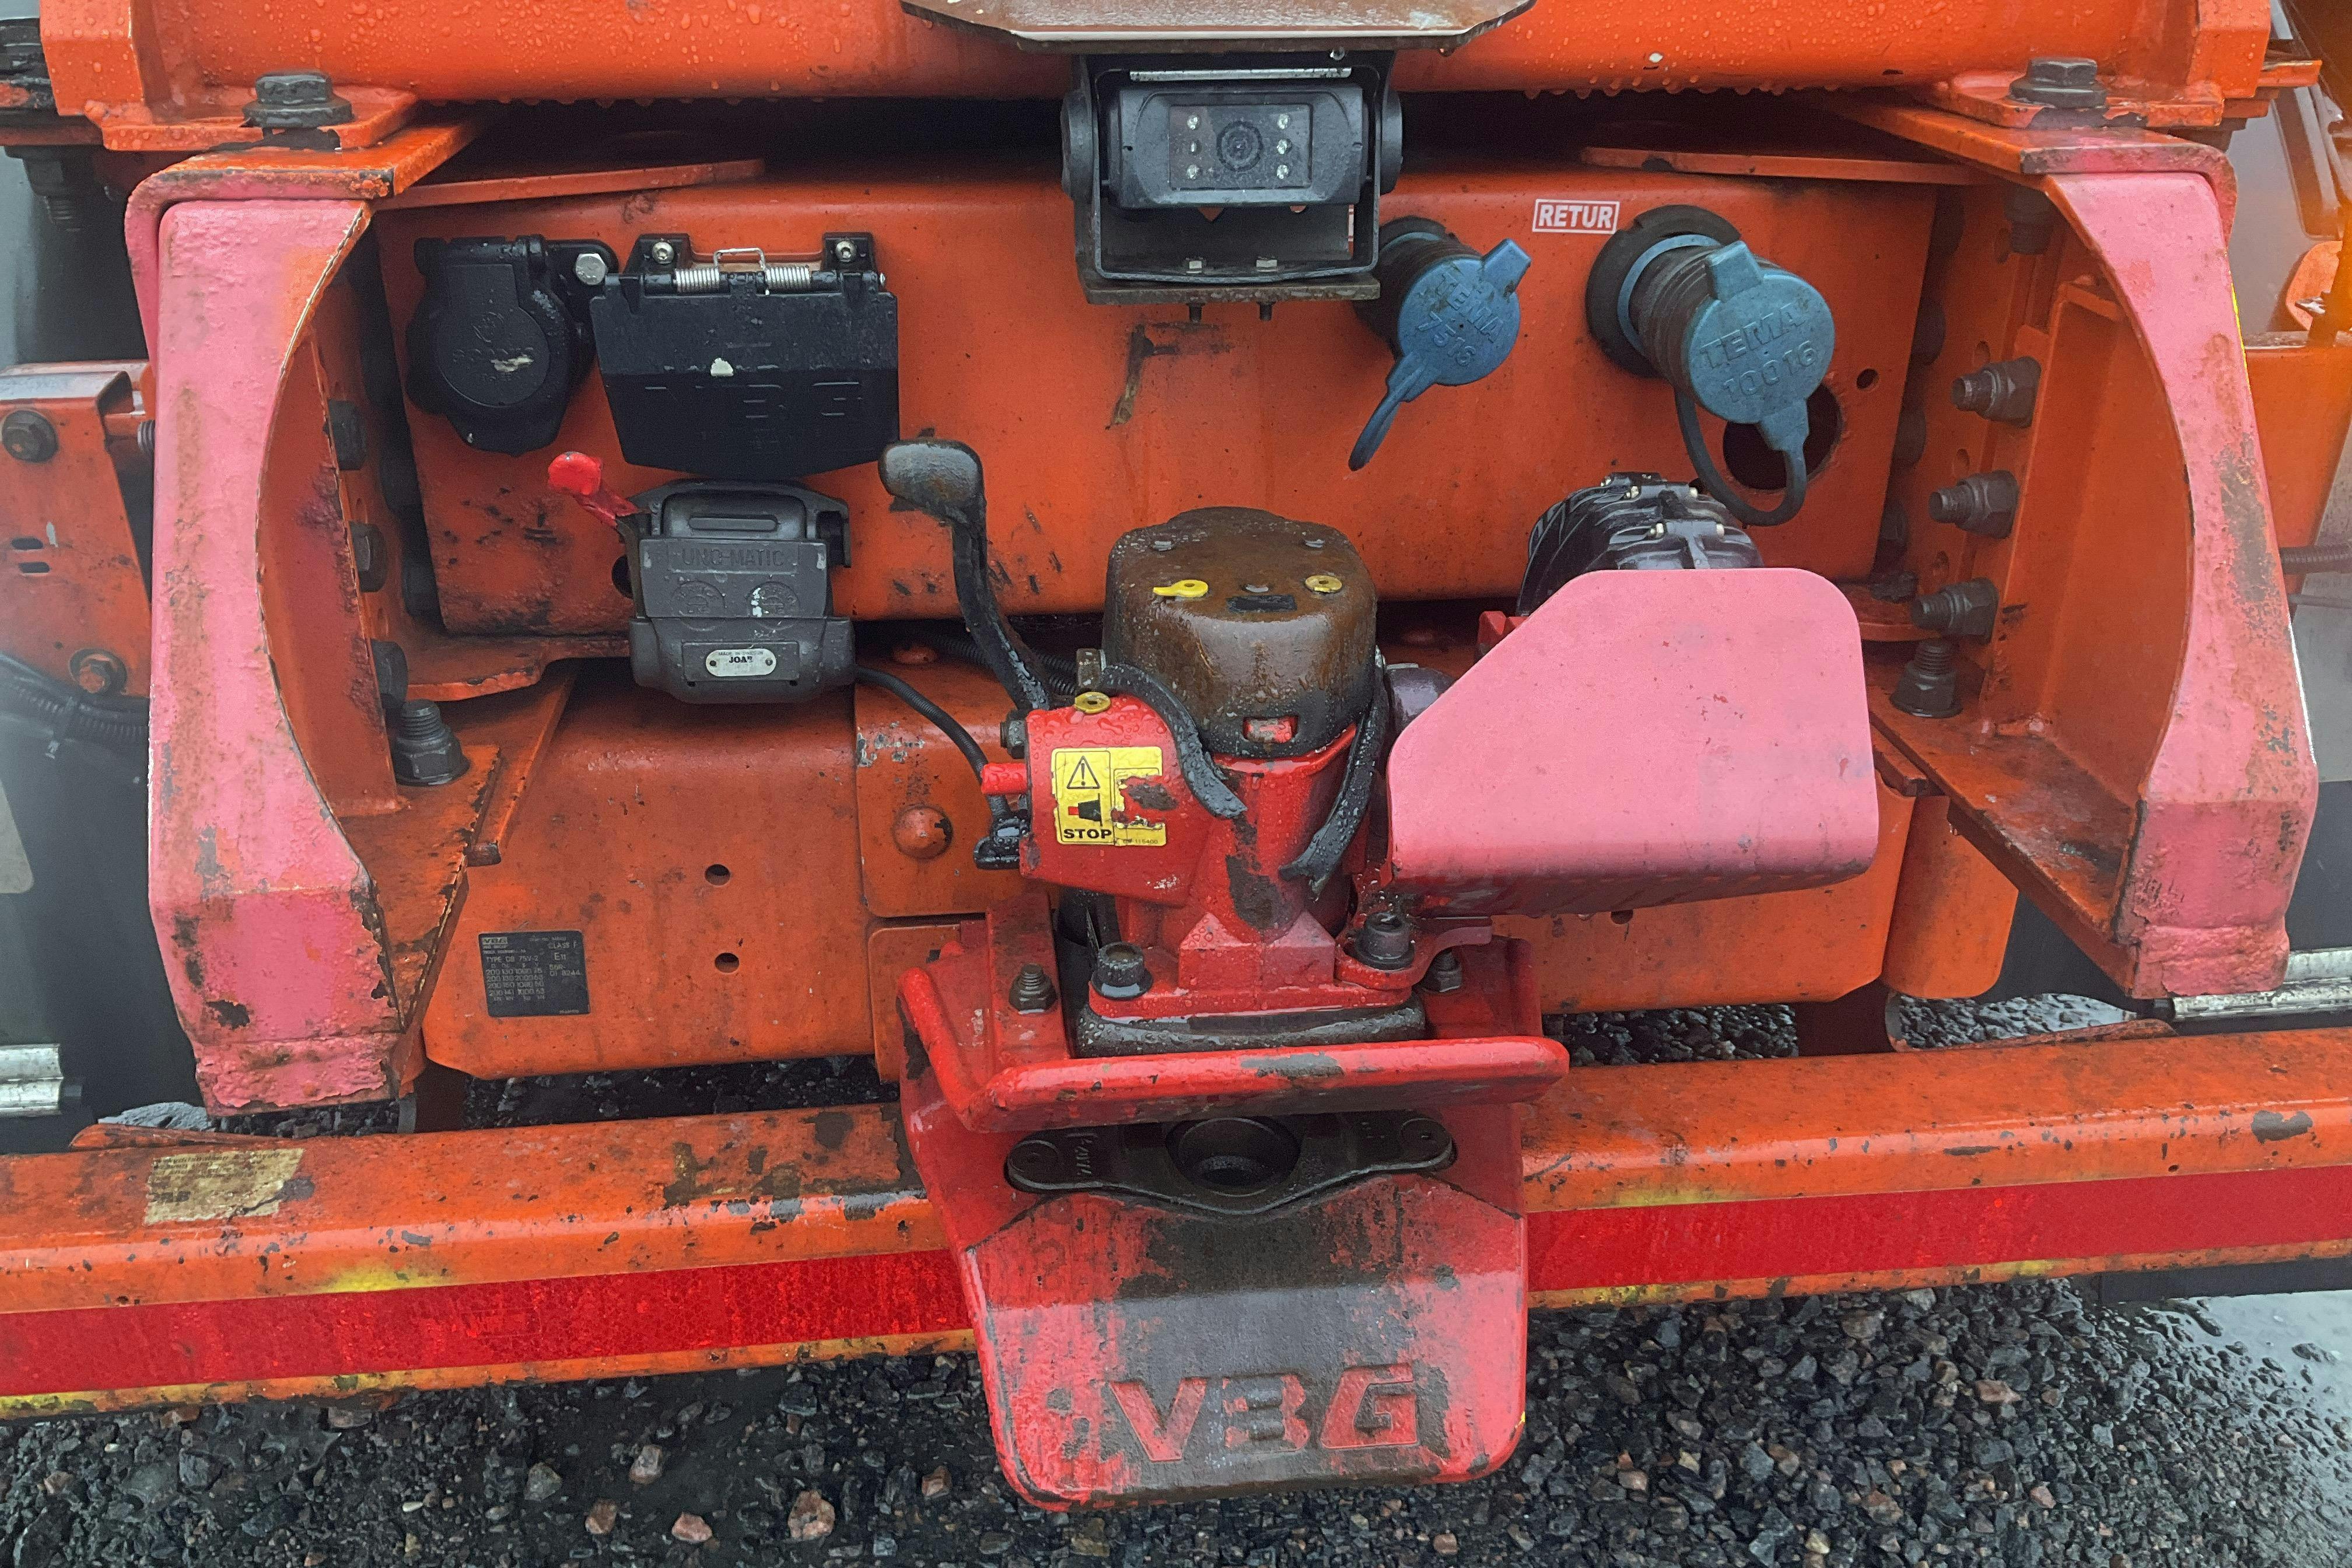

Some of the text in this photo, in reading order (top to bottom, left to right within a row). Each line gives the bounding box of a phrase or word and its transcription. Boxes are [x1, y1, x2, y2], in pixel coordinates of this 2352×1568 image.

[1538, 204, 1614, 229] RETUR
[1416, 310, 1476, 366] 7516
[1437, 270, 1503, 344] TEMA
[1700, 302, 1807, 369] TEMA
[1722, 340, 1818, 403] 10016
[1063, 828, 1112, 839] STOP
[1108, 1363, 1419, 1462] VBG
